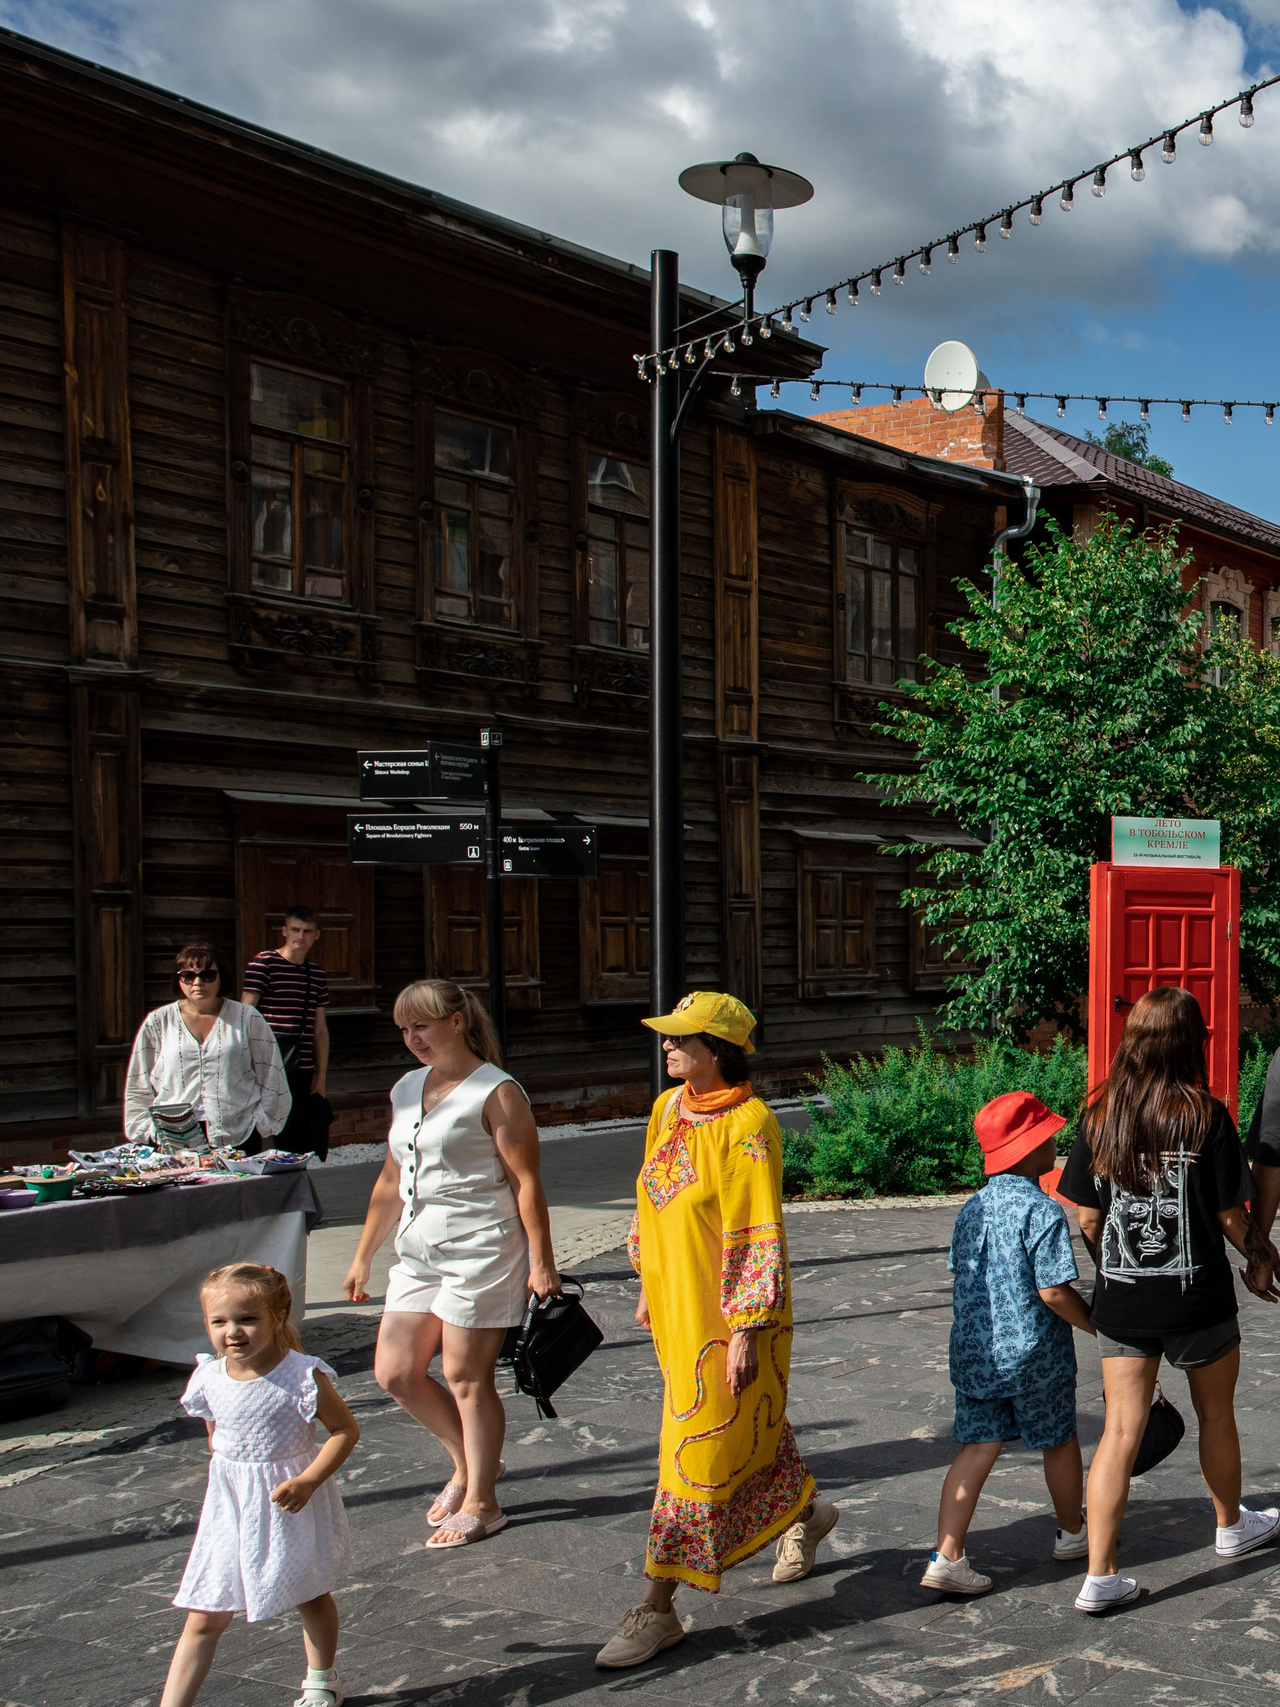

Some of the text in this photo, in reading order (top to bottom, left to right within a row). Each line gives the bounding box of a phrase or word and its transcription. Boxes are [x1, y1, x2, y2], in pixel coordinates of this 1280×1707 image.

[374, 760, 407, 768] Мастерская
[393, 823, 416, 831] Борцов
[1155, 819, 1181, 828] ЛЕТО
[1129, 829, 1206, 839] В ТОБОЛЬСКОМ
[1147, 840, 1189, 849] КРЕМЛЕ
